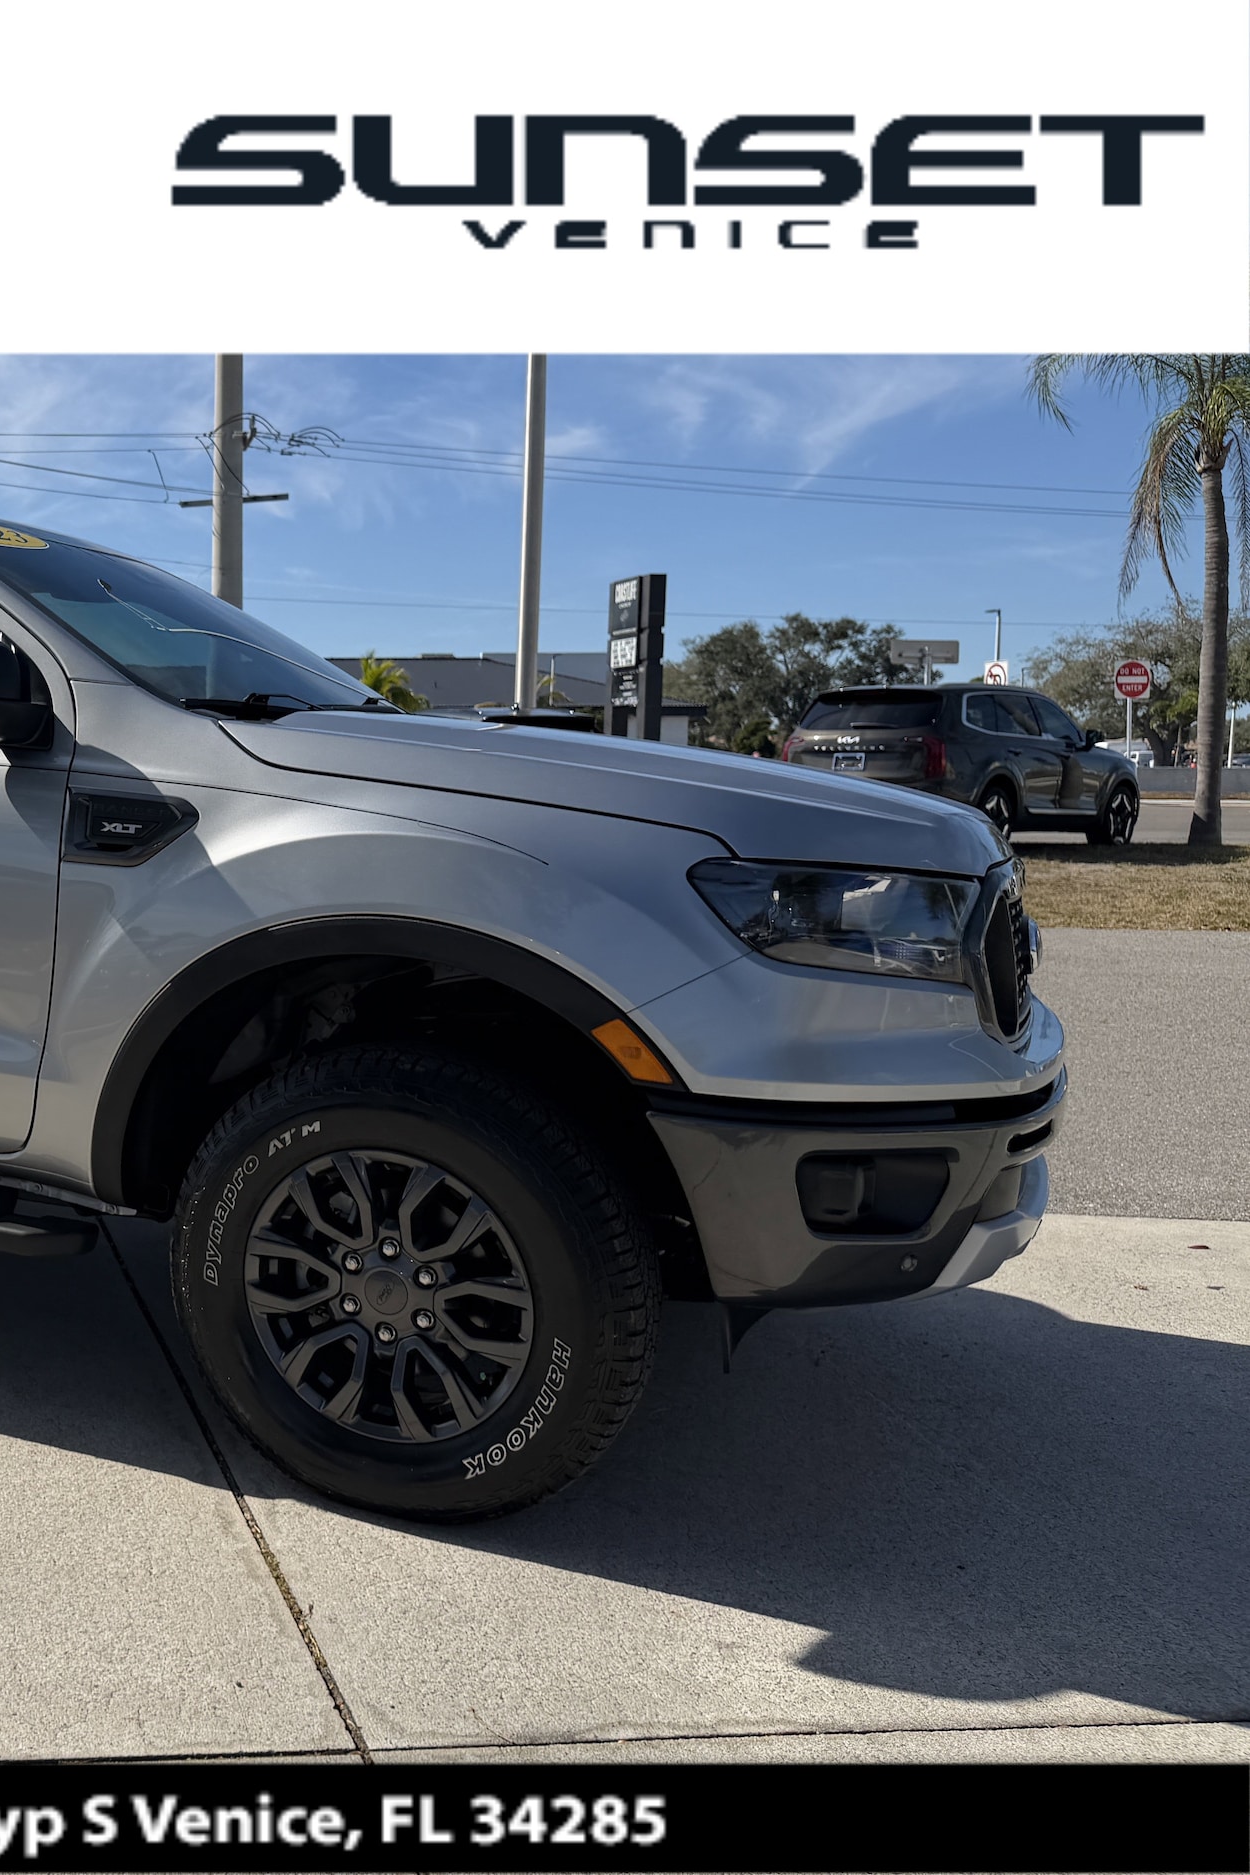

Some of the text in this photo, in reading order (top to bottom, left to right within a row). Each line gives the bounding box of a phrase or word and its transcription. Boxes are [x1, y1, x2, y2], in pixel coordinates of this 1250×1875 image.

[1120, 667, 1145, 675] DO NOT
[1122, 684, 1142, 692] ENTER
[100, 821, 143, 835] XLT
